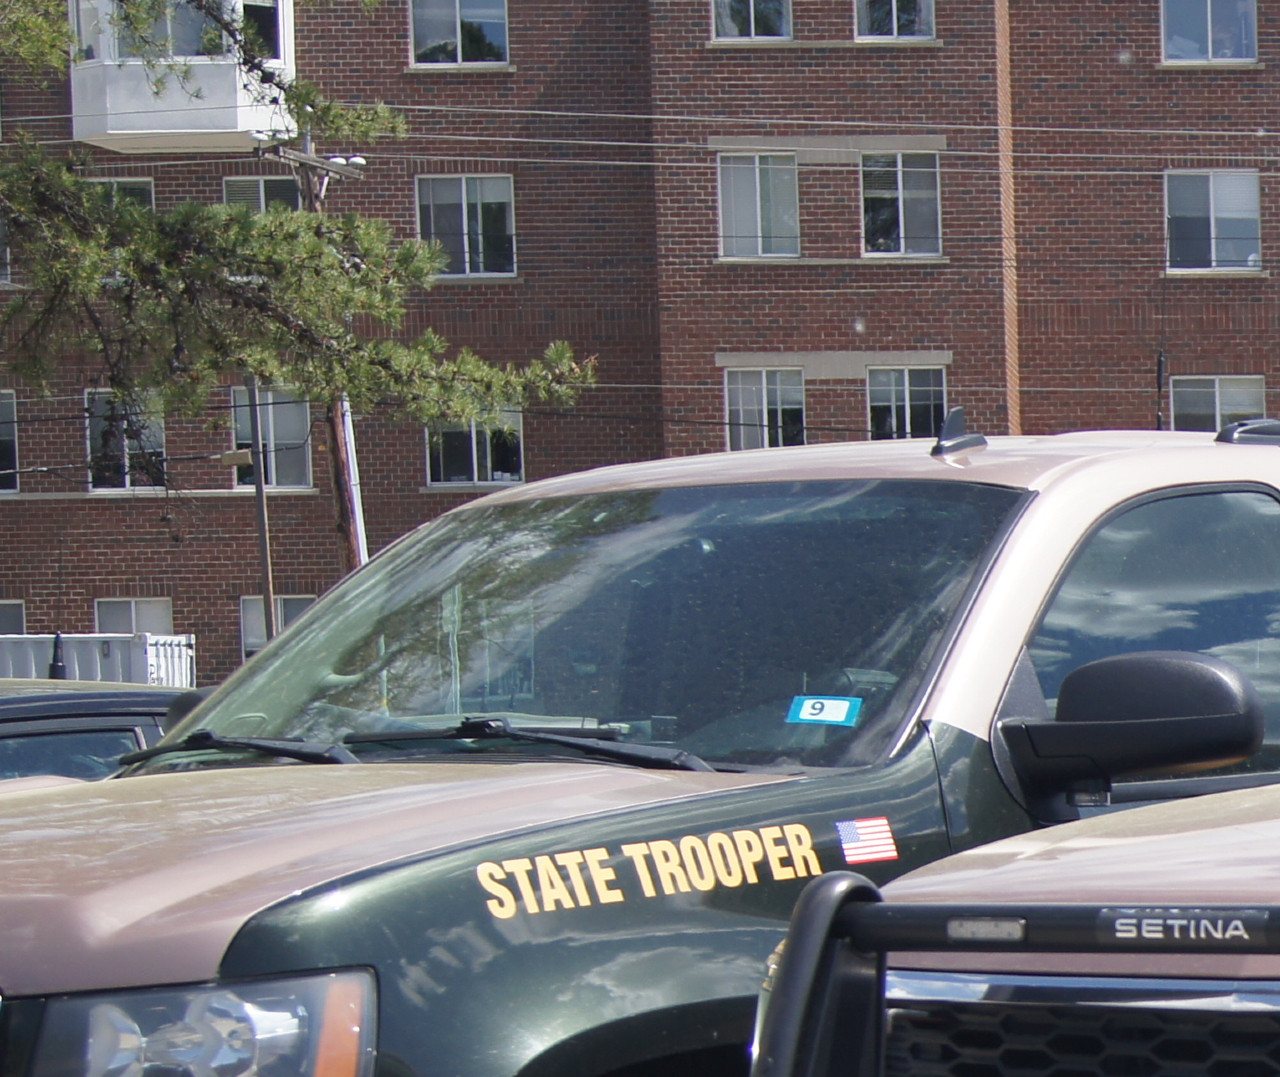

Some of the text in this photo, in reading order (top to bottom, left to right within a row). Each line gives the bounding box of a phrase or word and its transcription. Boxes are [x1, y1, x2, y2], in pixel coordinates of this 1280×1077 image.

[808, 700, 825, 717] 9
[476, 823, 824, 920] STATE TROOPER
[1113, 917, 1251, 941] SETINA
